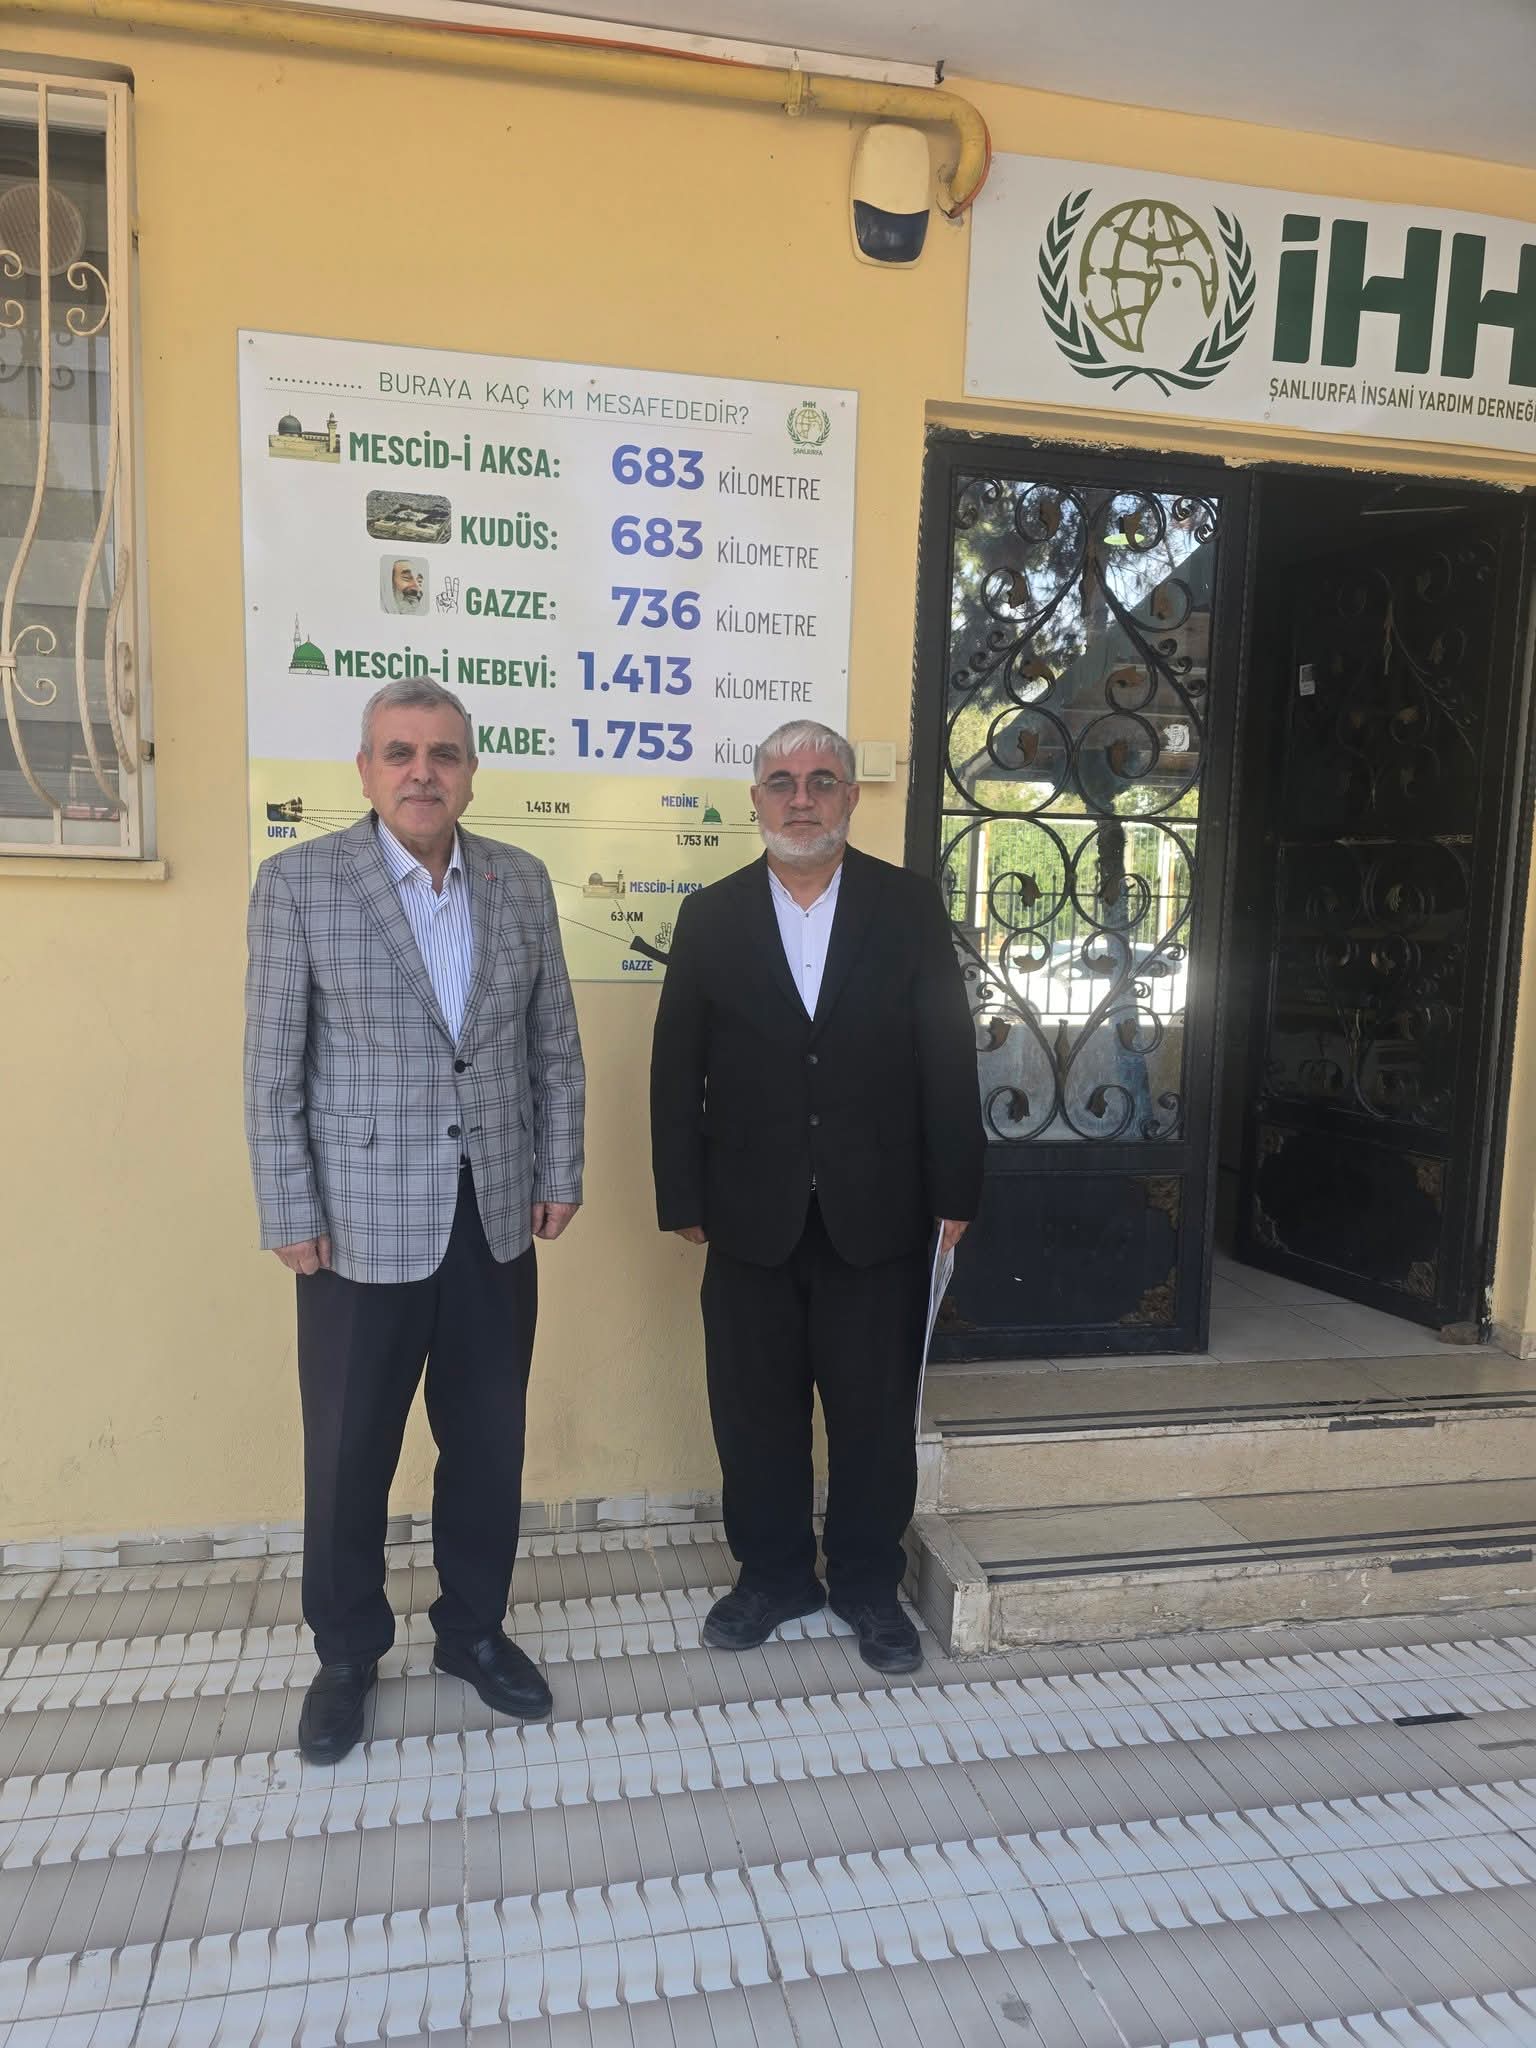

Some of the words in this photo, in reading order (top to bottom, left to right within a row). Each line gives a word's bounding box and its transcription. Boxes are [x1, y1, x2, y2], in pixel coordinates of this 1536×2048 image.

[379, 372, 472, 401] BURAYA
[486, 382, 529, 409] KAÇ
[543, 387, 574, 410] KM
[586, 391, 749, 425] MESAFEDEDİR?
[1269, 377, 1357, 404] ŞANLIURFA
[1361, 380, 1415, 409] İNSANİ
[1418, 389, 1474, 415] YARDIM
[349, 430, 471, 472] MESCİD-İ
[480, 444, 560, 480] AKSA:
[612, 444, 704, 490] 683
[719, 466, 820, 501] KİLOMETRE
[461, 511, 558, 552] KUDÜS:
[611, 515, 703, 560] 683
[717, 536, 819, 569] KİLOMETRE
[465, 587, 556, 620] GAZZE:
[611, 586, 701, 631] 736
[716, 604, 817, 637] KİLOMETRE
[334, 646, 449, 682] MESCİD-İ
[458, 654, 556, 688] NEBEVİ:
[577, 651, 692, 696] 1.413
[715, 672, 813, 702] KİLOMETRE
[478, 725, 555, 755] KABE:
[571, 718, 693, 762] 1.753
[526, 800, 552, 813] 1.413
[554, 802, 570, 814] KM
[661, 793, 699, 808] MEDİNE
[267, 825, 297, 839] URFA
[676, 834, 702, 846] 1.753
[704, 836, 719, 847] KM
[630, 879, 674, 894] MESCİD-İ
[610, 911, 624, 922] 63
[626, 911, 644, 922] KM
[621, 960, 654, 972] GAZZE
